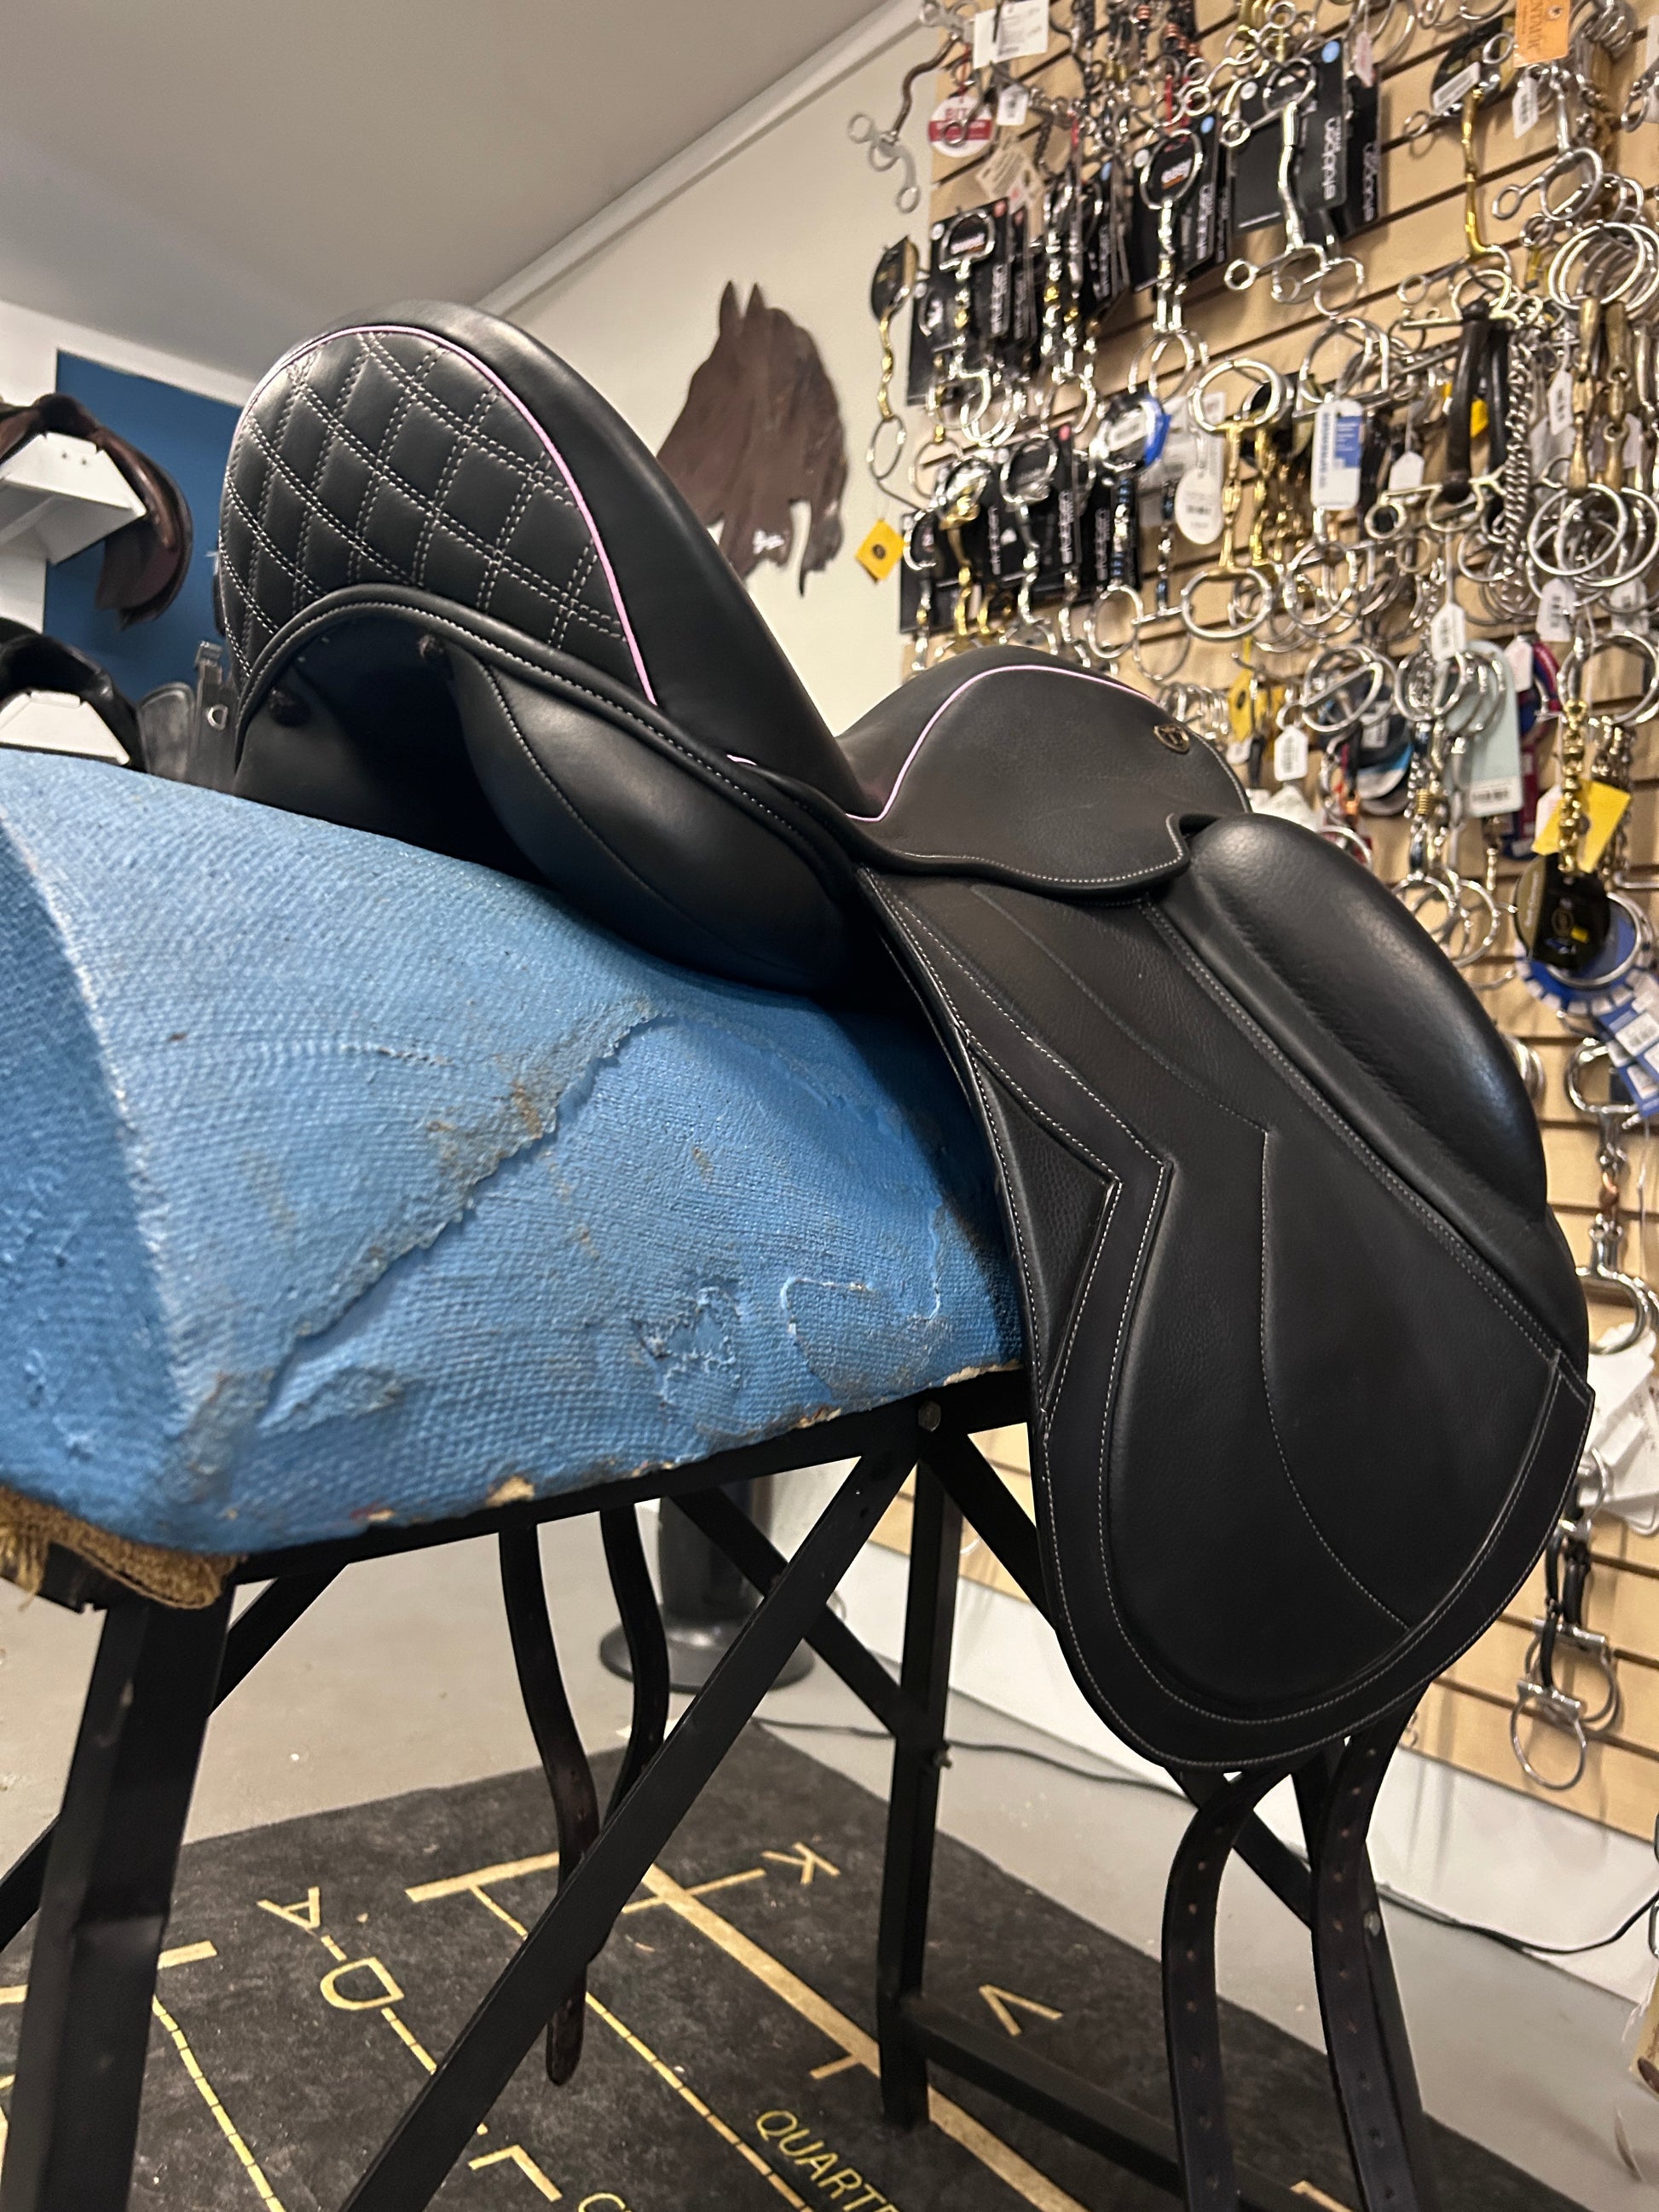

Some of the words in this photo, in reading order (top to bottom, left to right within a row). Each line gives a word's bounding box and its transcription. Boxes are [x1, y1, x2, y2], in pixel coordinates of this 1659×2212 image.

[761, 1842, 840, 1885] K
[257, 1886, 320, 1930] A
[320, 1957, 405, 2011] D
[468, 2144, 563, 2203] L
